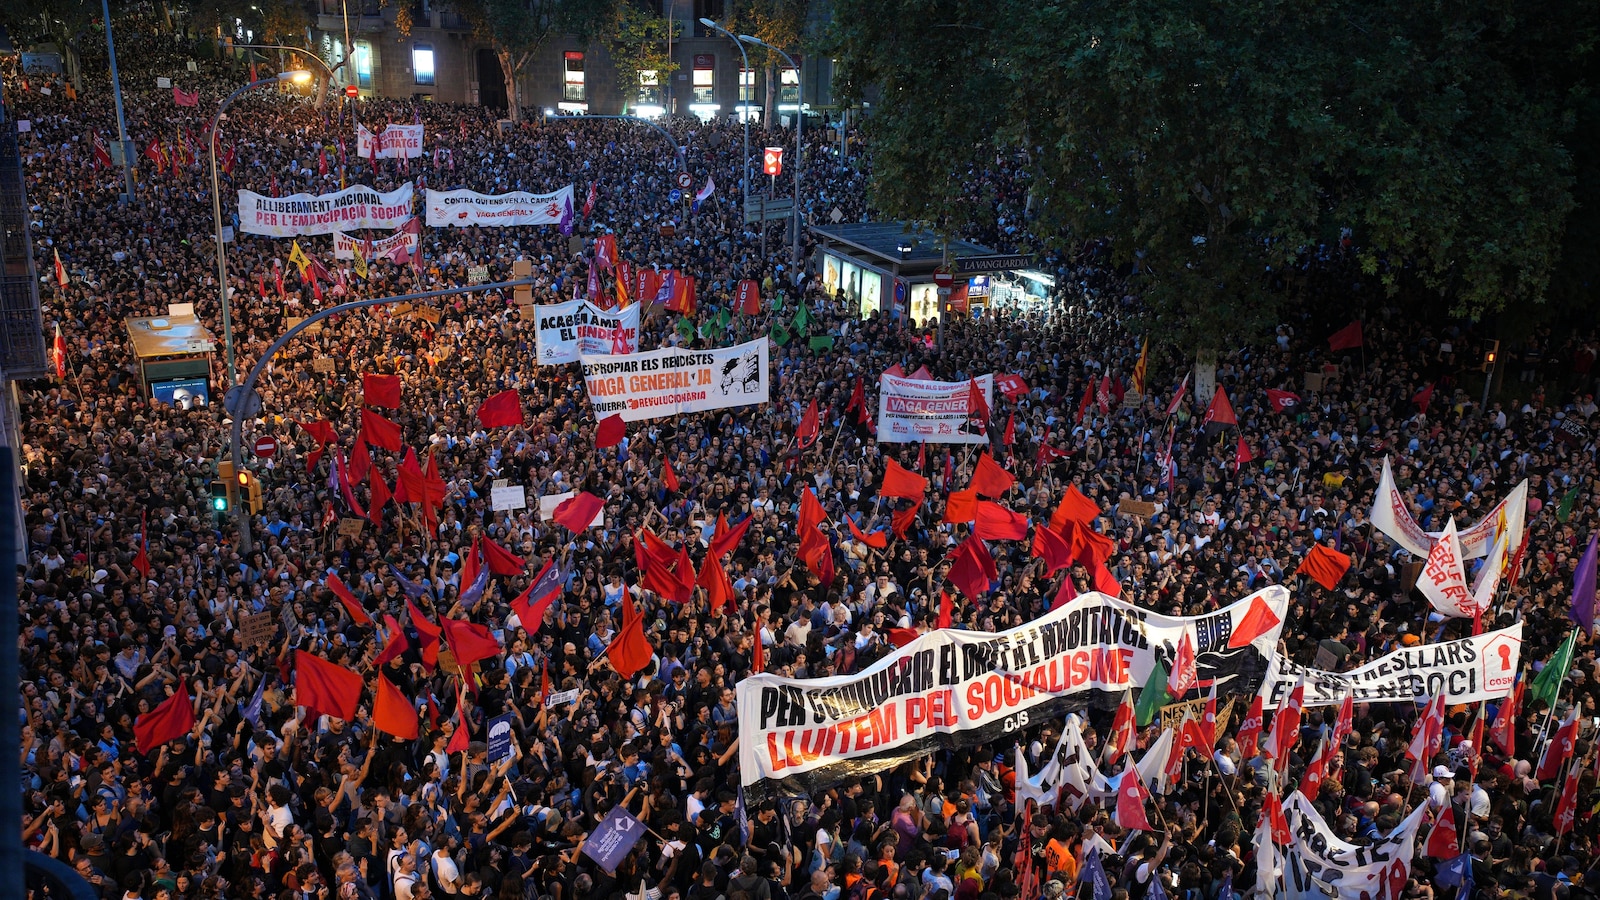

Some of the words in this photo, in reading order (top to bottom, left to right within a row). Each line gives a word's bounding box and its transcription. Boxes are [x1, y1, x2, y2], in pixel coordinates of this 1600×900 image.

[256, 198, 331, 214] ALLIBERAMENT
[334, 193, 383, 210] NACIONAL
[444, 197, 474, 205] CONTRA
[497, 209, 529, 217] GENERAL
[256, 211, 277, 226] PER
[282, 202, 367, 227] L'EMANCIPACIÓ
[964, 260, 976, 270] LA
[976, 258, 1029, 269] VANGUARDIA
[639, 273, 647, 300] UGT
[739, 283, 750, 308] UGT
[560, 328, 576, 342] EL
[582, 360, 639, 376] EXPROPIAR
[641, 358, 659, 371] ELS
[662, 353, 715, 369] RENDISTES
[587, 374, 627, 397] VAGA
[629, 371, 691, 393] GENERAL
[696, 368, 712, 386] JA
[890, 399, 923, 412] VAGA
[925, 400, 968, 412] GENER
[1404, 638, 1477, 669] LLARS
[760, 685, 806, 730] PER
[939, 642, 960, 686] EL
[1376, 667, 1476, 699] NEGOCI
[766, 703, 899, 772] LLUITEM
[905, 689, 959, 735] PEL
[966, 648, 1134, 720] SOCIALISME
